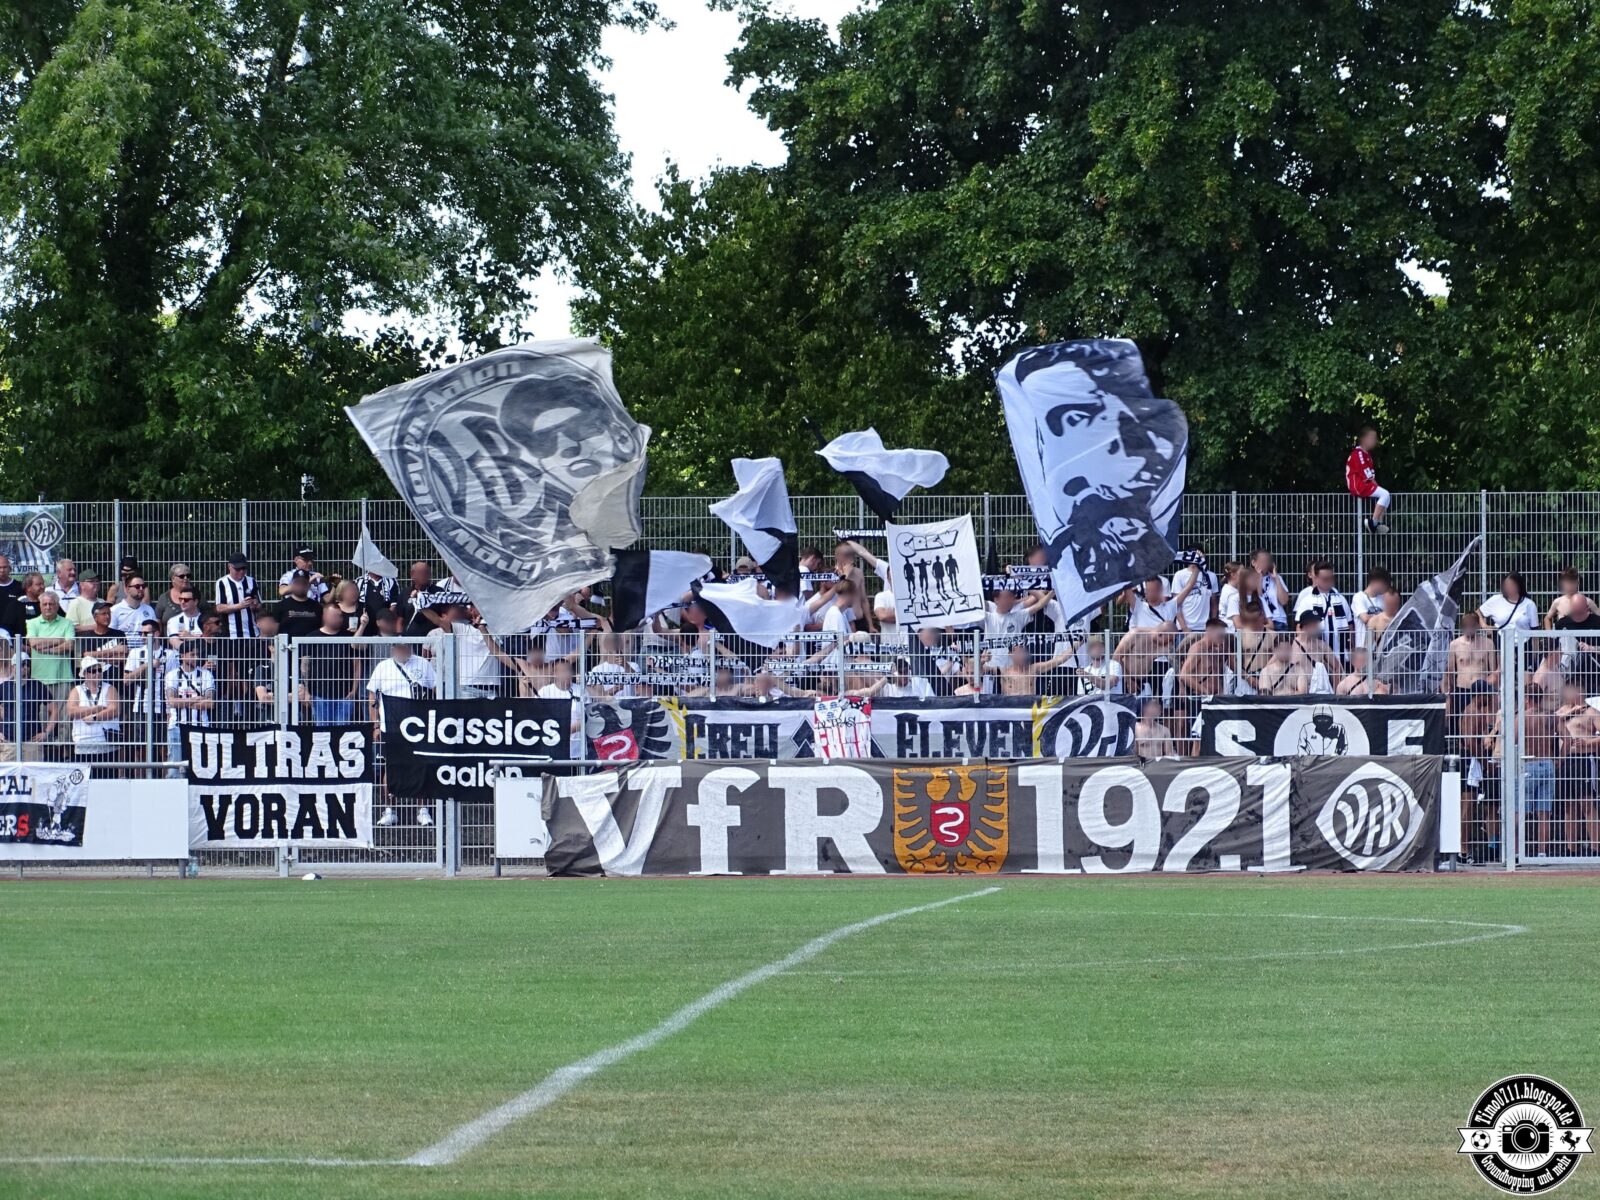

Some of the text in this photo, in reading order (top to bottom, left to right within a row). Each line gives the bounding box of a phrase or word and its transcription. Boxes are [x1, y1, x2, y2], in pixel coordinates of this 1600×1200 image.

[425, 360, 522, 412] Aalen
[404, 413, 445, 523] Eleven
[448, 528, 542, 581] Crew
[400, 709, 561, 746] classics
[684, 713, 780, 759] CREW
[894, 712, 1034, 758] ELEVEN
[188, 731, 365, 780] ULTRAS
[200, 793, 356, 841] VORAN
[555, 764, 1307, 875] VfR 1921
